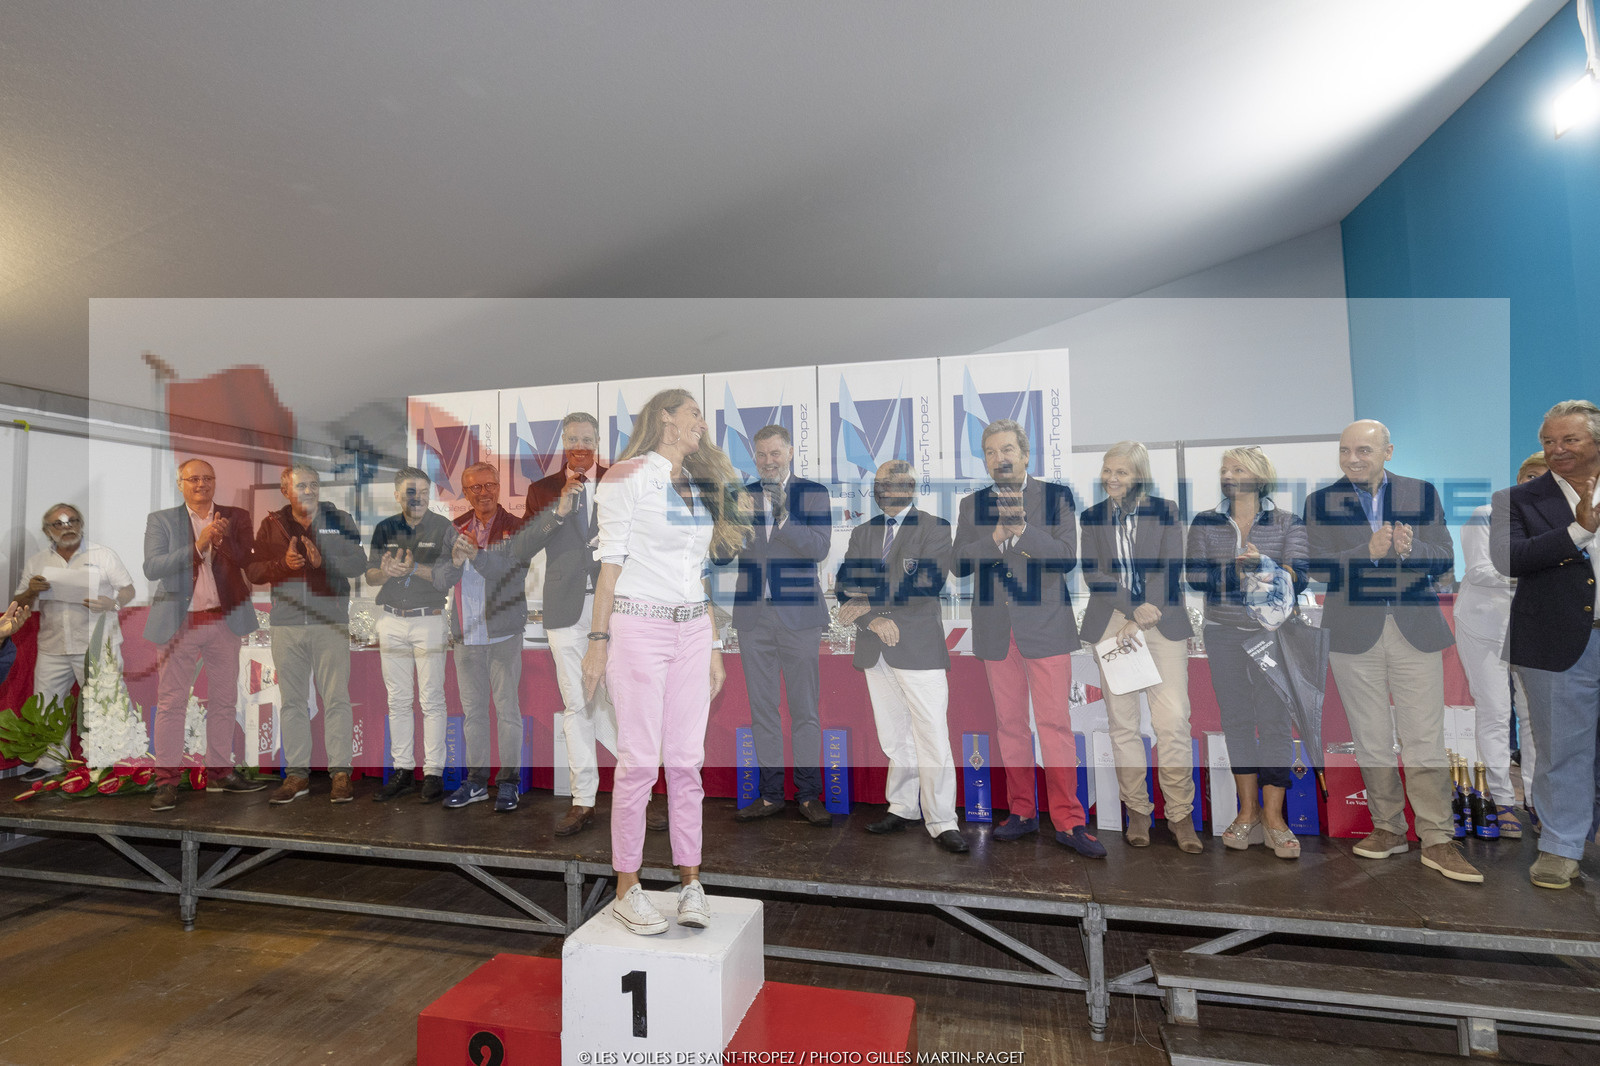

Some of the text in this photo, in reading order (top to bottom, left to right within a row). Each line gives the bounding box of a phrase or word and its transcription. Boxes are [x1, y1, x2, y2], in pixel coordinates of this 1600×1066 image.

[919, 395, 931, 496] Saint-Tropez
[831, 489, 856, 499] Les
[742, 732, 753, 799] POMMERY
[829, 734, 841, 804] POMMERY
[621, 970, 648, 1038] 1
